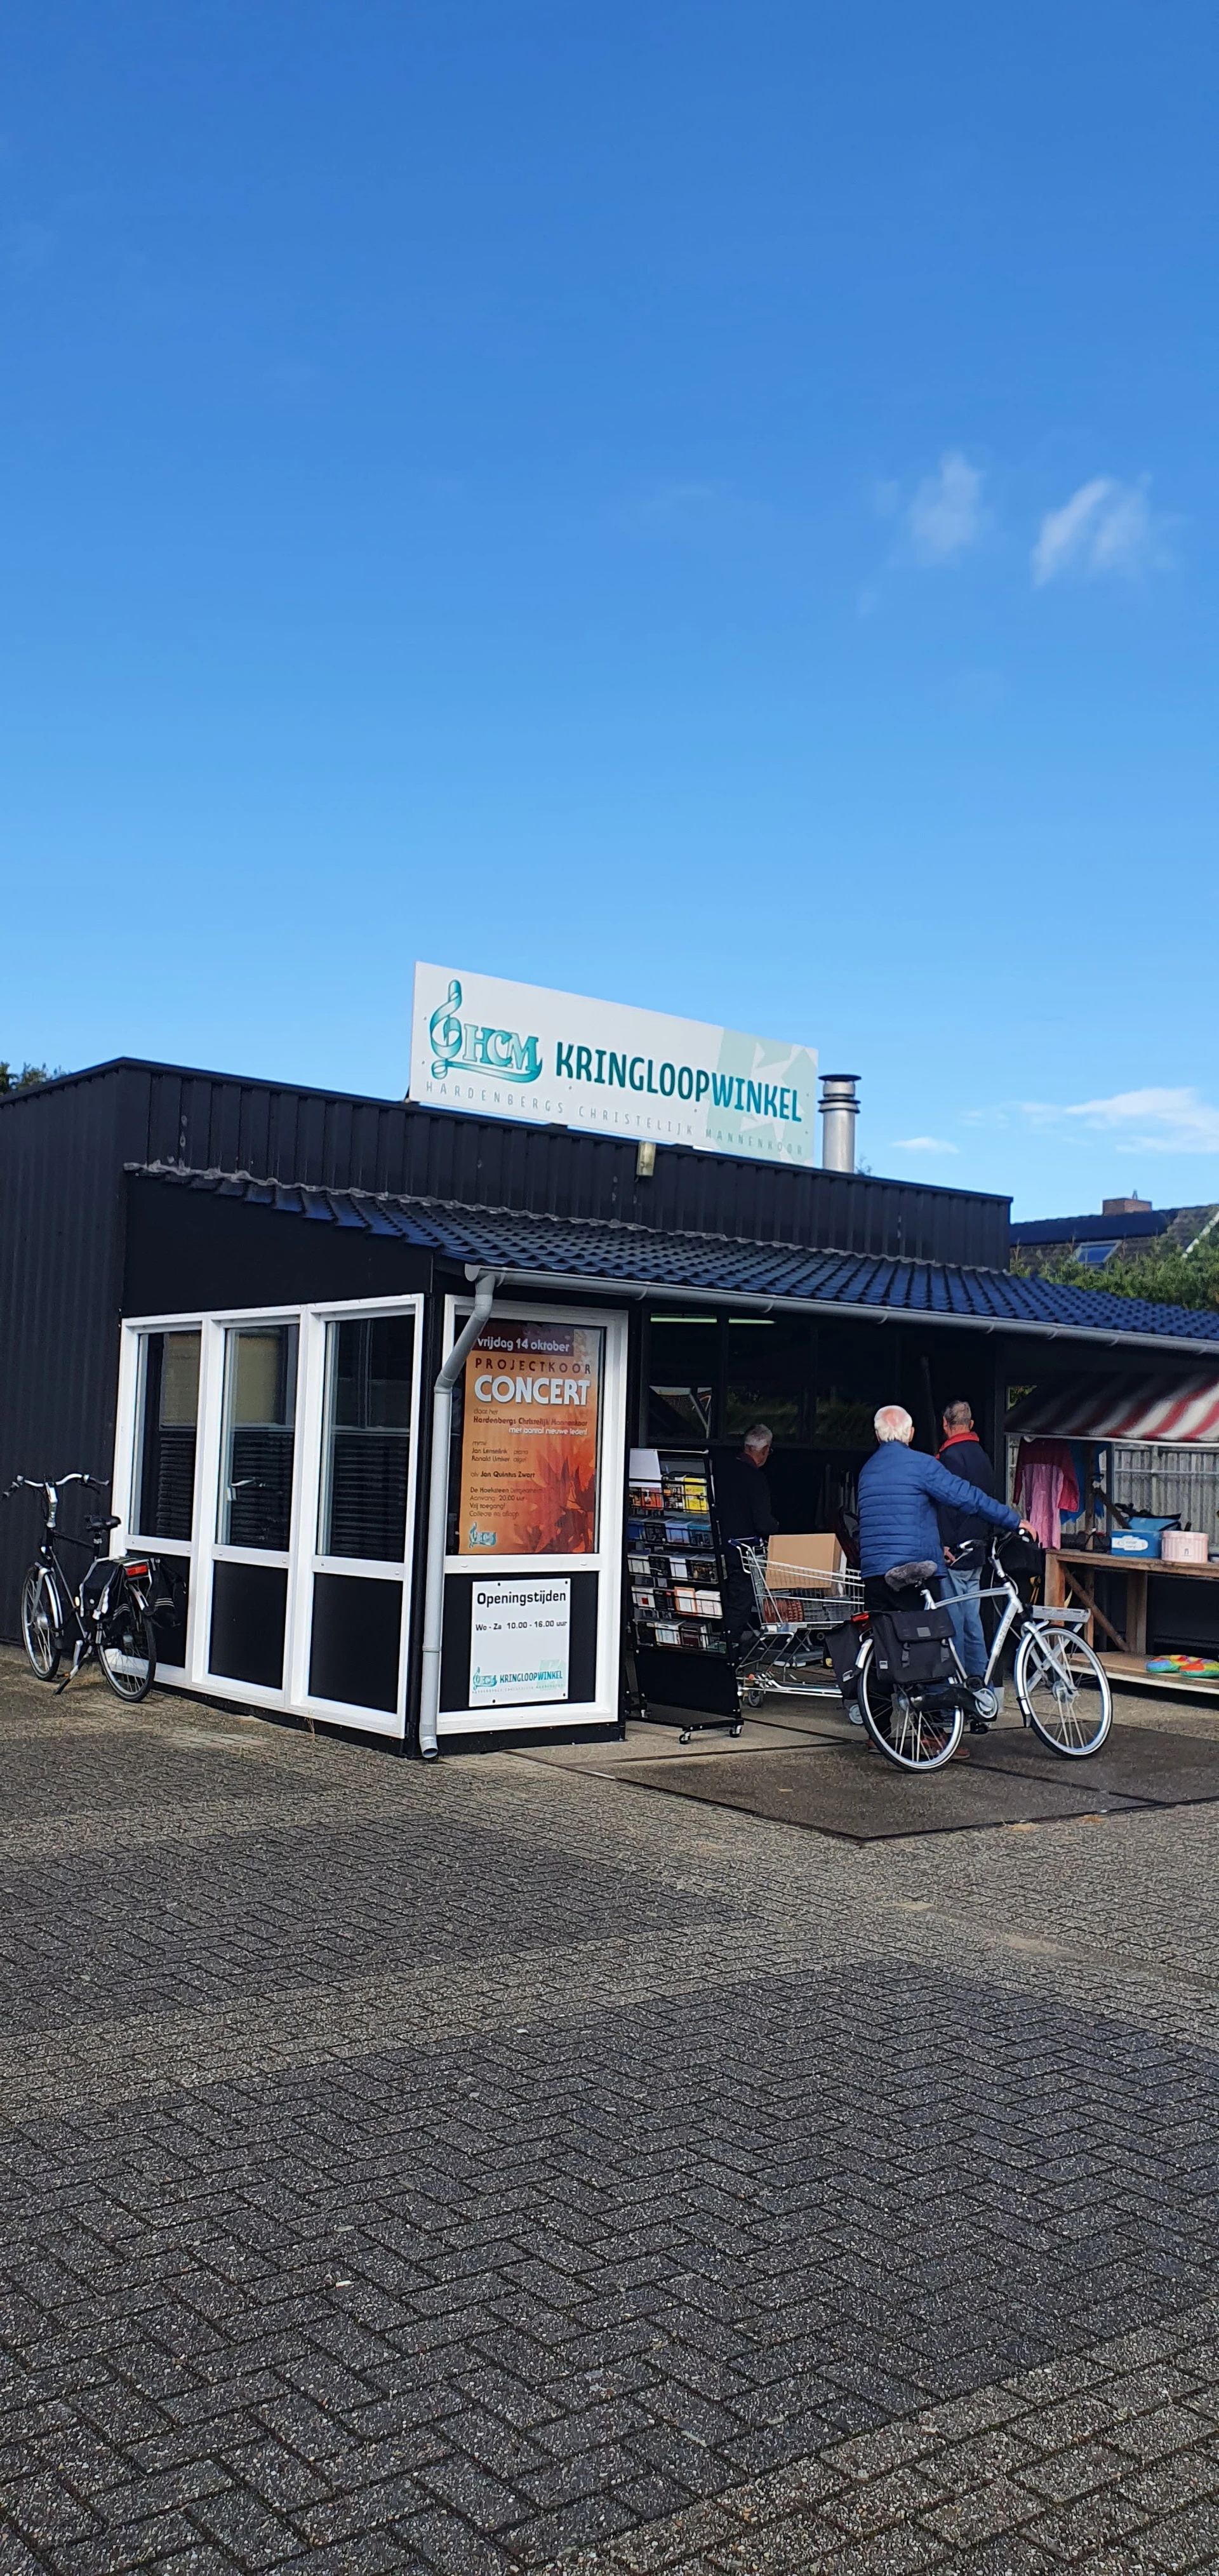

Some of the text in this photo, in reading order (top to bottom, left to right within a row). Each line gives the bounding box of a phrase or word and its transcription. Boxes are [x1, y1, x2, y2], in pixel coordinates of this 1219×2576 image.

[463, 1022, 539, 1072] HCM
[556, 1041, 802, 1122] KRINGLOOPWINKEL
[426, 1080, 803, 1155] HARDENBERGS CHRISTELIJK MANNENKOOR
[477, 1336, 570, 1352] vrijdag 14 oktober
[475, 1358, 591, 1374] PROJECTKOOR
[474, 1374, 590, 1406] CONCERT
[473, 1417, 516, 1425] Hardenbergs
[518, 1417, 549, 1427] Christelijk
[477, 1590, 566, 1608] Openingstijden
[507, 1621, 528, 1629] 10.00
[500, 1671, 563, 1683] KRINGLOOPWINKEL
